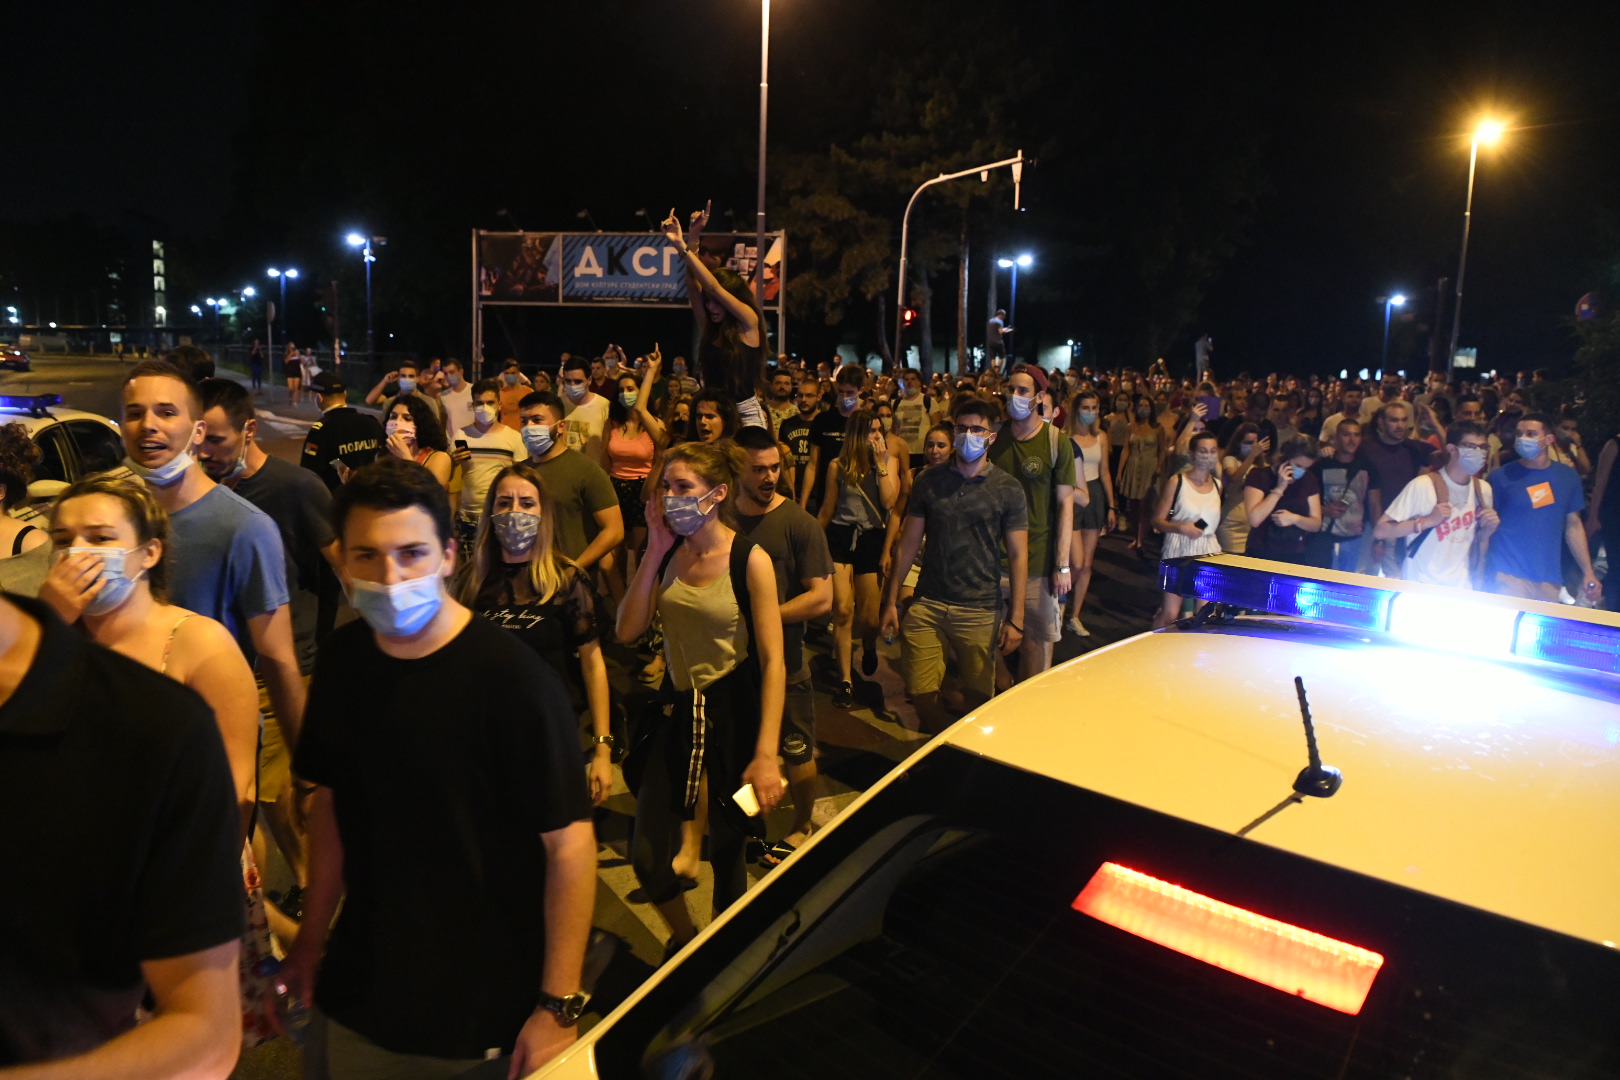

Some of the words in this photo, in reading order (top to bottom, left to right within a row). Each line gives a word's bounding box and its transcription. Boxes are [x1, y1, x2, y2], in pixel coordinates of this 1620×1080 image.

[574, 245, 680, 278] ДКСГ
[574, 281, 590, 289] ДОМ
[338, 438, 382, 455] ПОЛИЦИ
